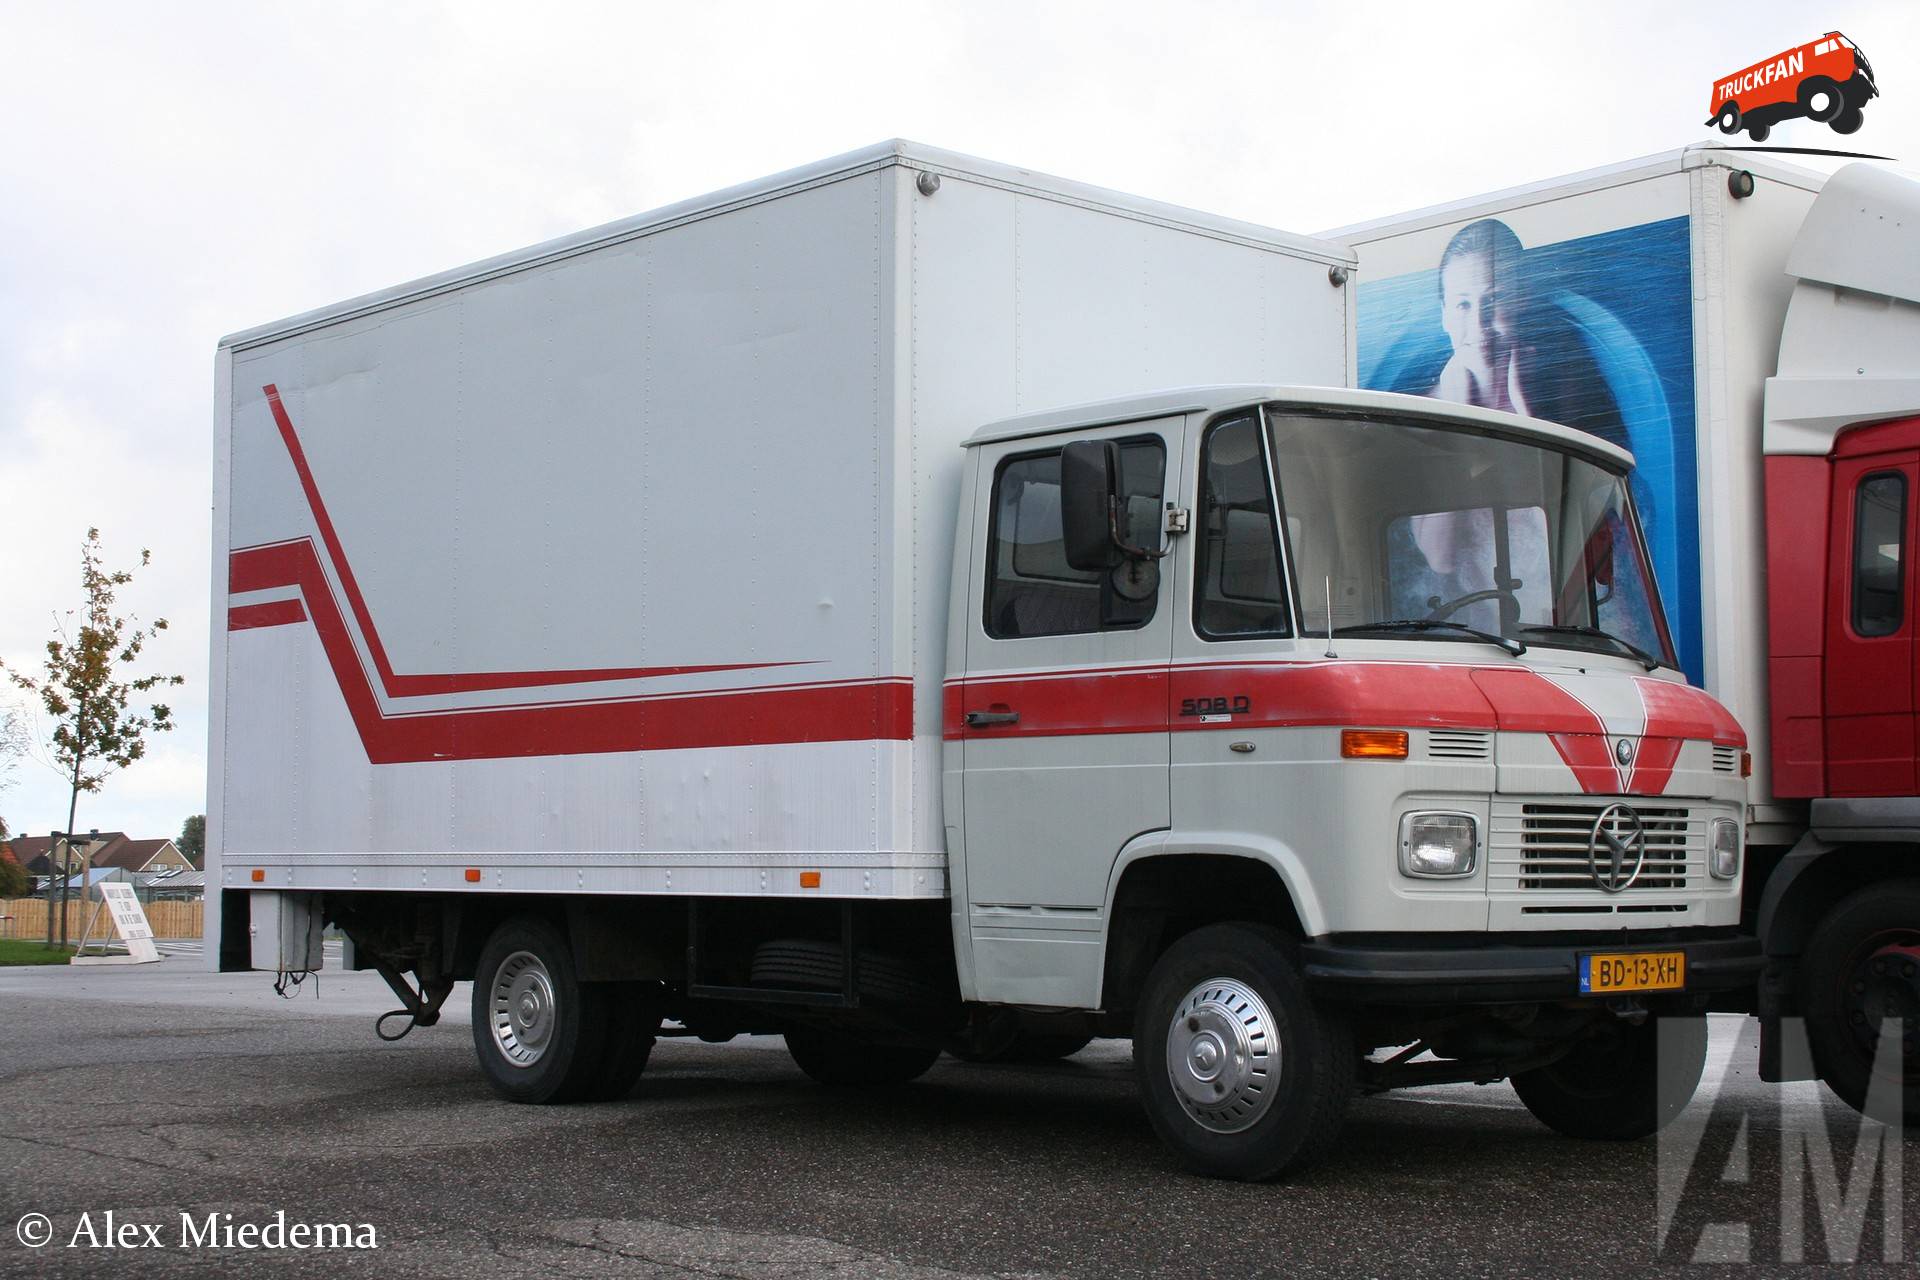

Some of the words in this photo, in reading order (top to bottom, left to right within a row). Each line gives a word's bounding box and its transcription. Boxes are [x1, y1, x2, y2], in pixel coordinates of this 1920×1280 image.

[1182, 697, 1228, 715] 508
[1234, 696, 1250, 714] D
[1581, 977, 1590, 986] NL
[1600, 957, 1677, 987] BD-13-XH
